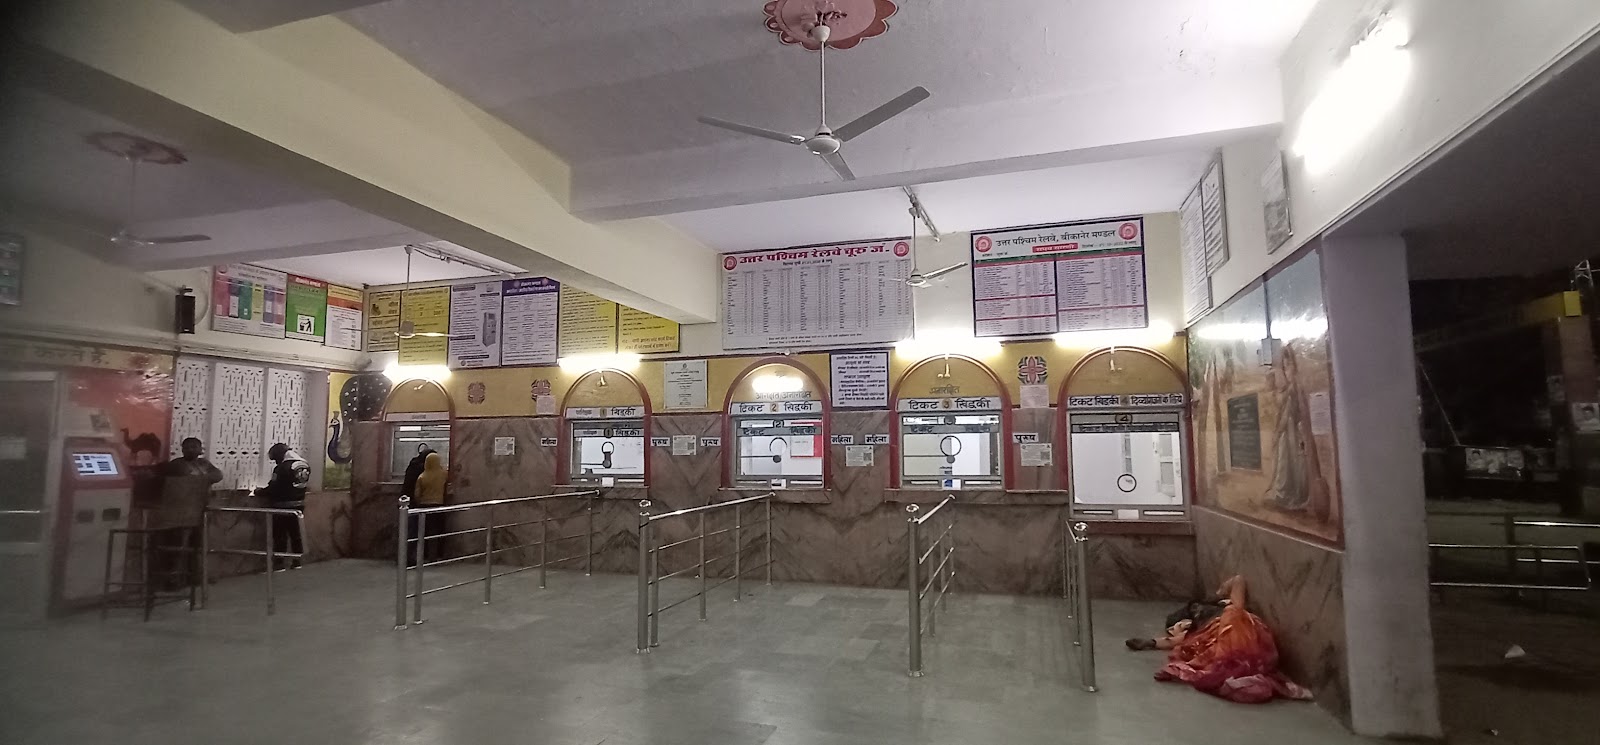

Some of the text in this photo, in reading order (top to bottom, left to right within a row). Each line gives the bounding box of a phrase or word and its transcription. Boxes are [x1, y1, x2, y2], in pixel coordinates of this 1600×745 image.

[996, 238, 1011, 247] उत्तर
[1012, 234, 1037, 244] पश्चिम
[1061, 229, 1090, 241] बीकानेर
[1091, 229, 1116, 237] मण्डल
[739, 256, 763, 264] उत्तर
[766, 251, 808, 261] पश्चिम
[810, 247, 842, 258] रेलवे
[908, 399, 939, 409] टिकट
[1069, 396, 1094, 406] टिकट
[739, 402, 764, 413] टिकट
[771, 404, 777, 412] 2
[831, 435, 851, 444] महिला
[865, 434, 887, 444] महिला
